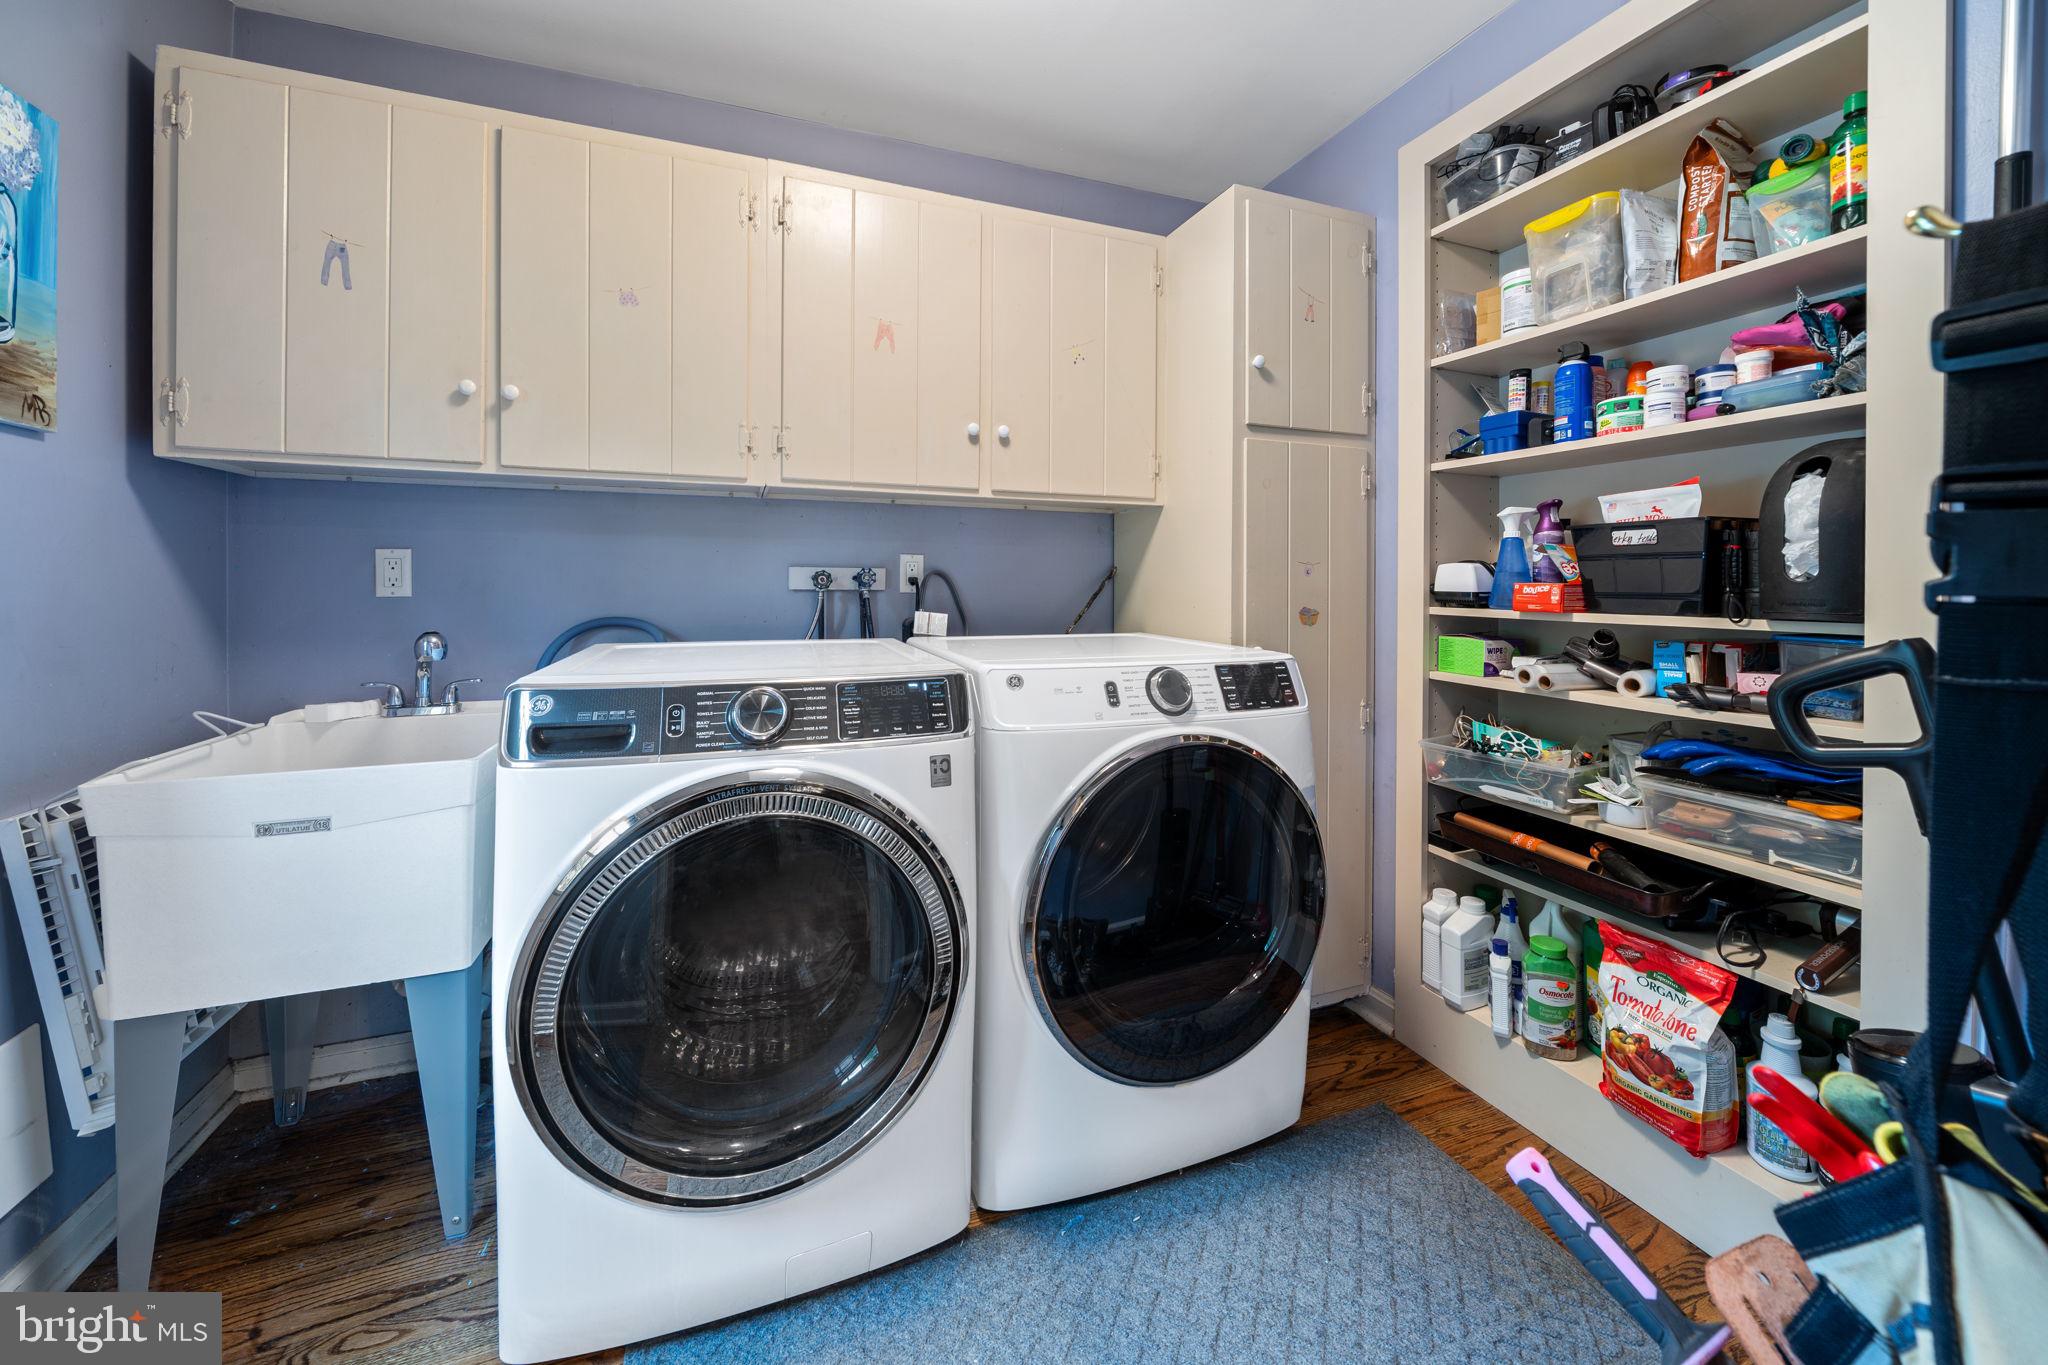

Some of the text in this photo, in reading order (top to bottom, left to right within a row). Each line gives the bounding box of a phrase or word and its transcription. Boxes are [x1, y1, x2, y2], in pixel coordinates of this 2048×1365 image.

[1687, 166, 1702, 212] COMPOST
[1612, 531, 1633, 544] erky
[1523, 585, 1551, 595] bounce
[930, 758, 951, 774] 10
[706, 786, 756, 803] ULTRAFRESH
[759, 783, 779, 793] VENT
[1538, 986, 1575, 999] Osmocote
[1636, 975, 1693, 1008] ORGANIC
[1610, 974, 1698, 1042] Tomato-tone
[1614, 1076, 1642, 1095] ORGANIC
[1643, 1092, 1693, 1119] GARDENING
